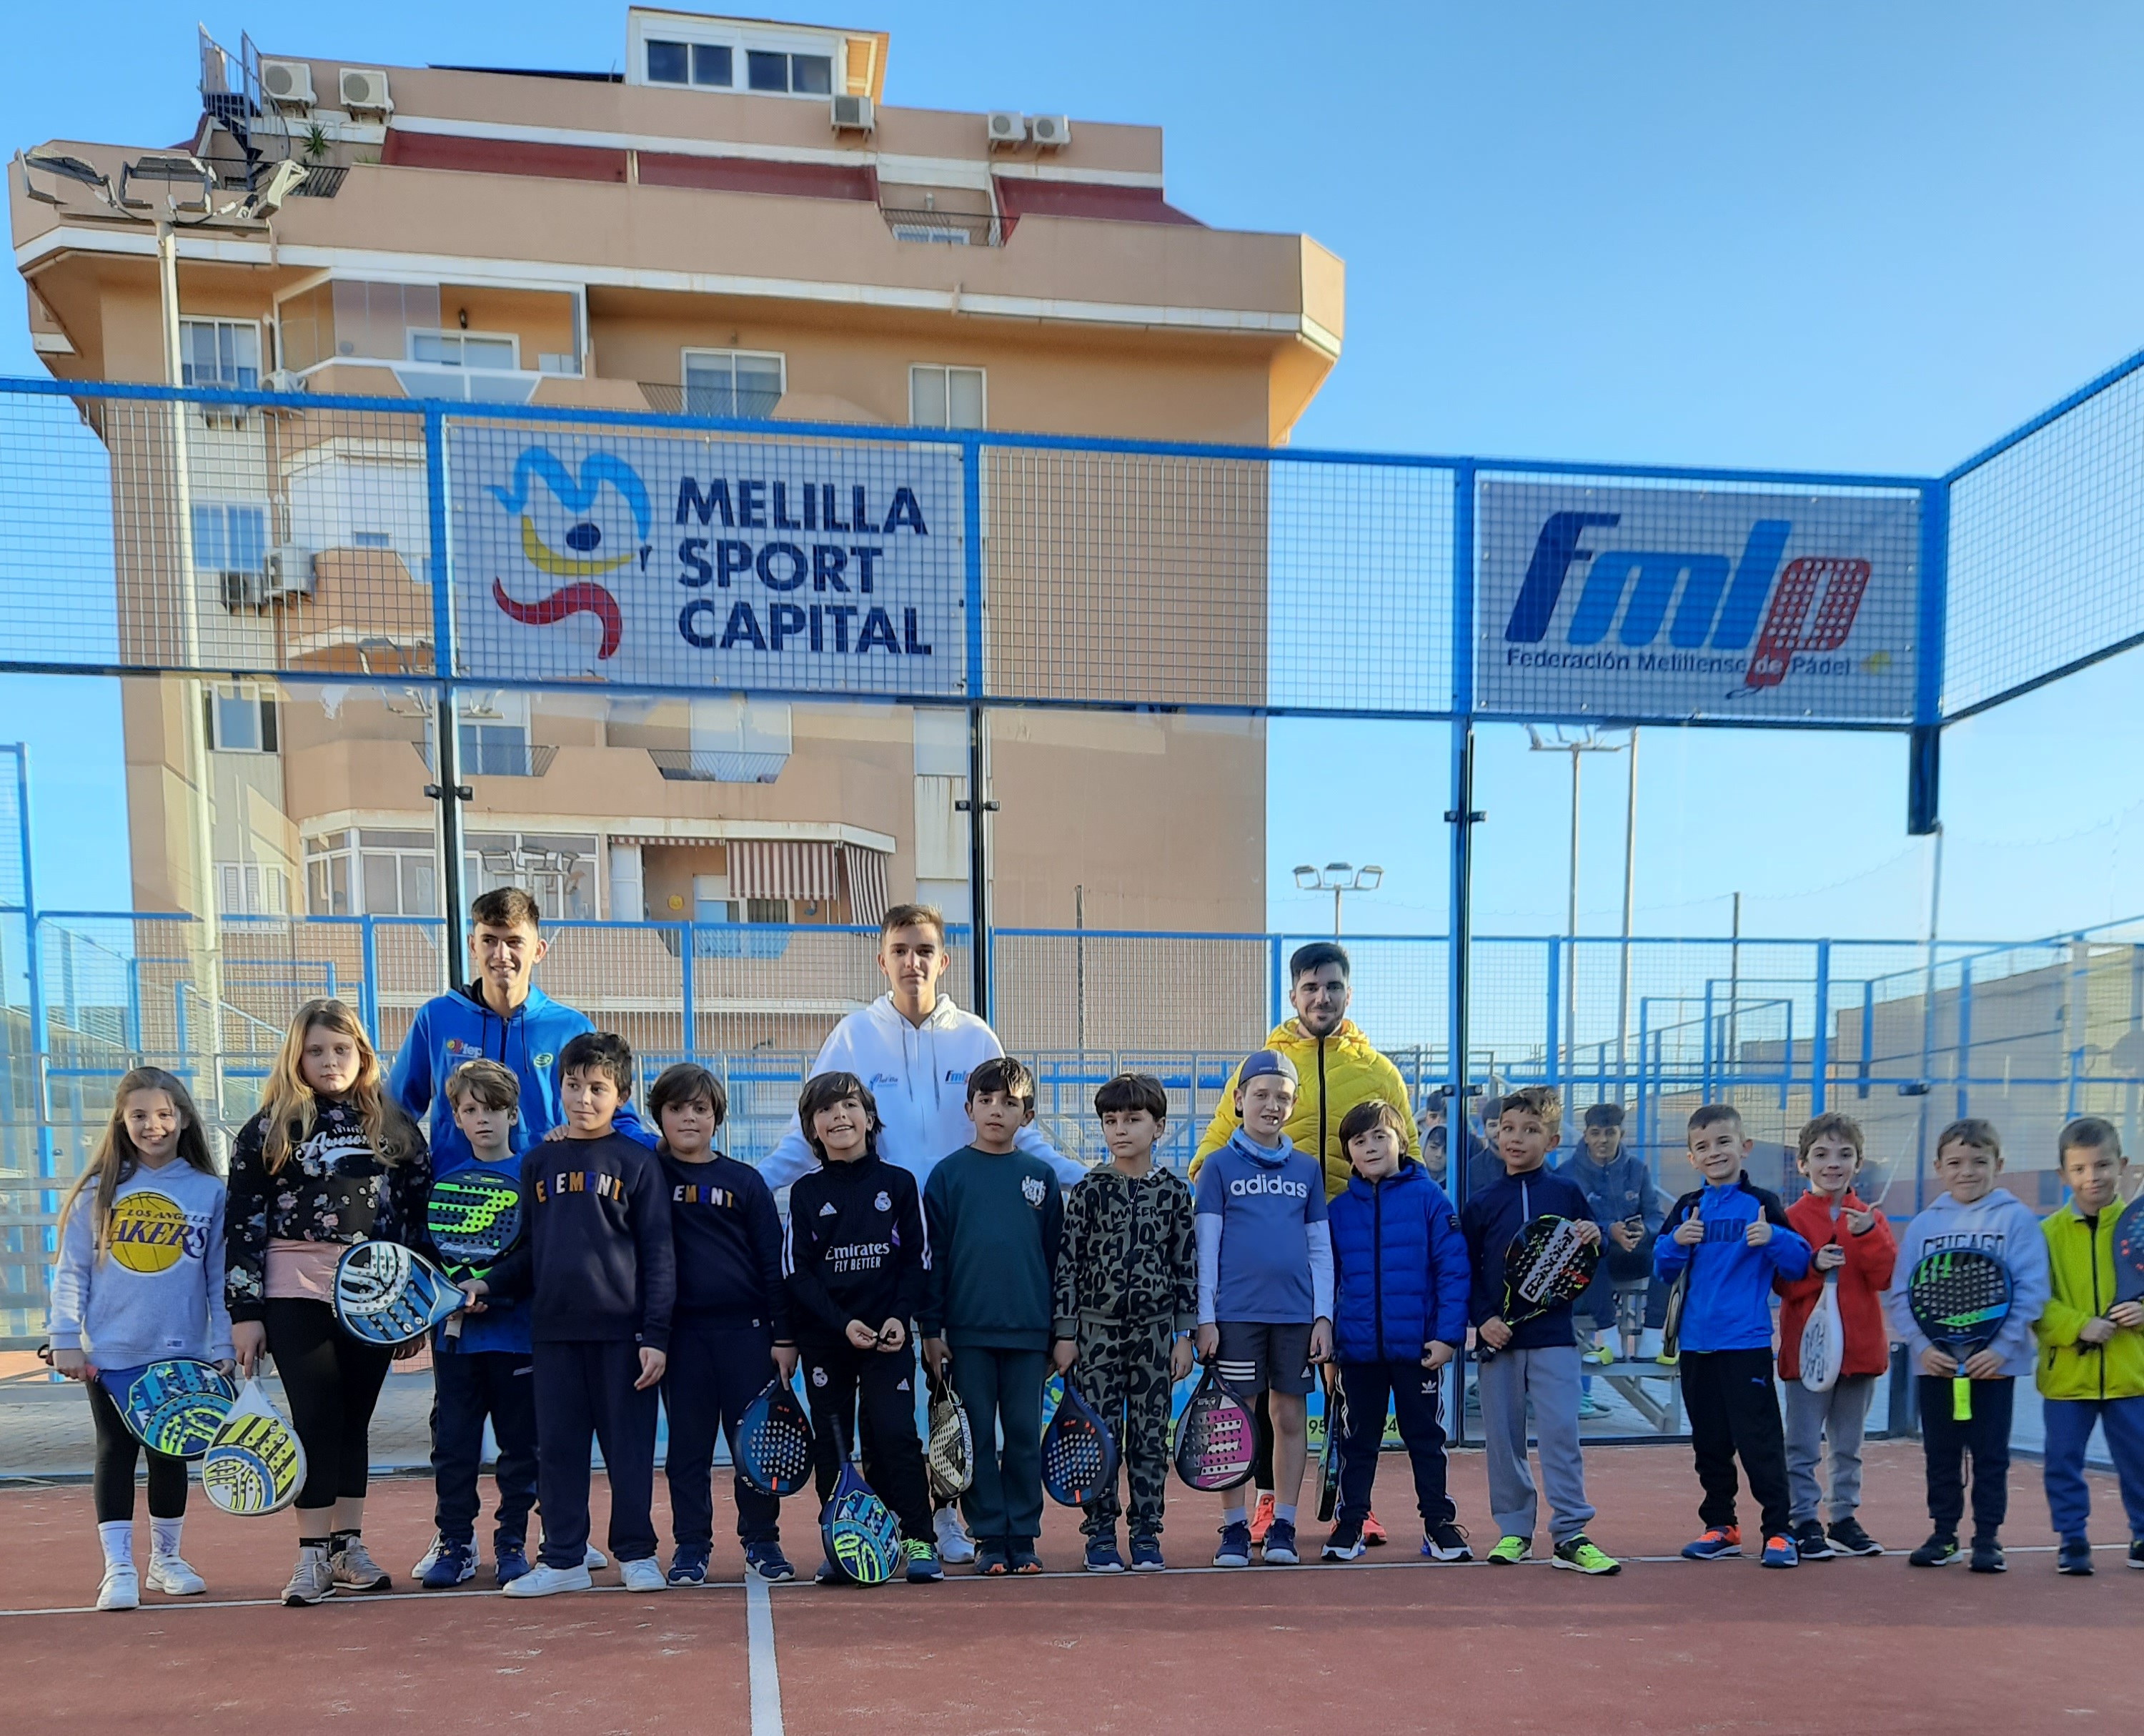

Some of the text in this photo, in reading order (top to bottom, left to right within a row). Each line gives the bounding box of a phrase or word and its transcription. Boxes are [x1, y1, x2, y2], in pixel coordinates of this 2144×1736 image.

[675, 476, 928, 535] MELILLA
[678, 538, 883, 593] SPORT
[678, 600, 932, 655] CAPITAL
[1507, 646, 1850, 676] Federación Melillense de Pádel
[536, 1171, 623, 1203] ELEMENT
[1230, 1174, 1307, 1199] adidas
[127, 1209, 213, 1224] LOS ANGELES
[825, 1243, 890, 1260] Emirates
[834, 1256, 881, 1272] FLY BETTER
